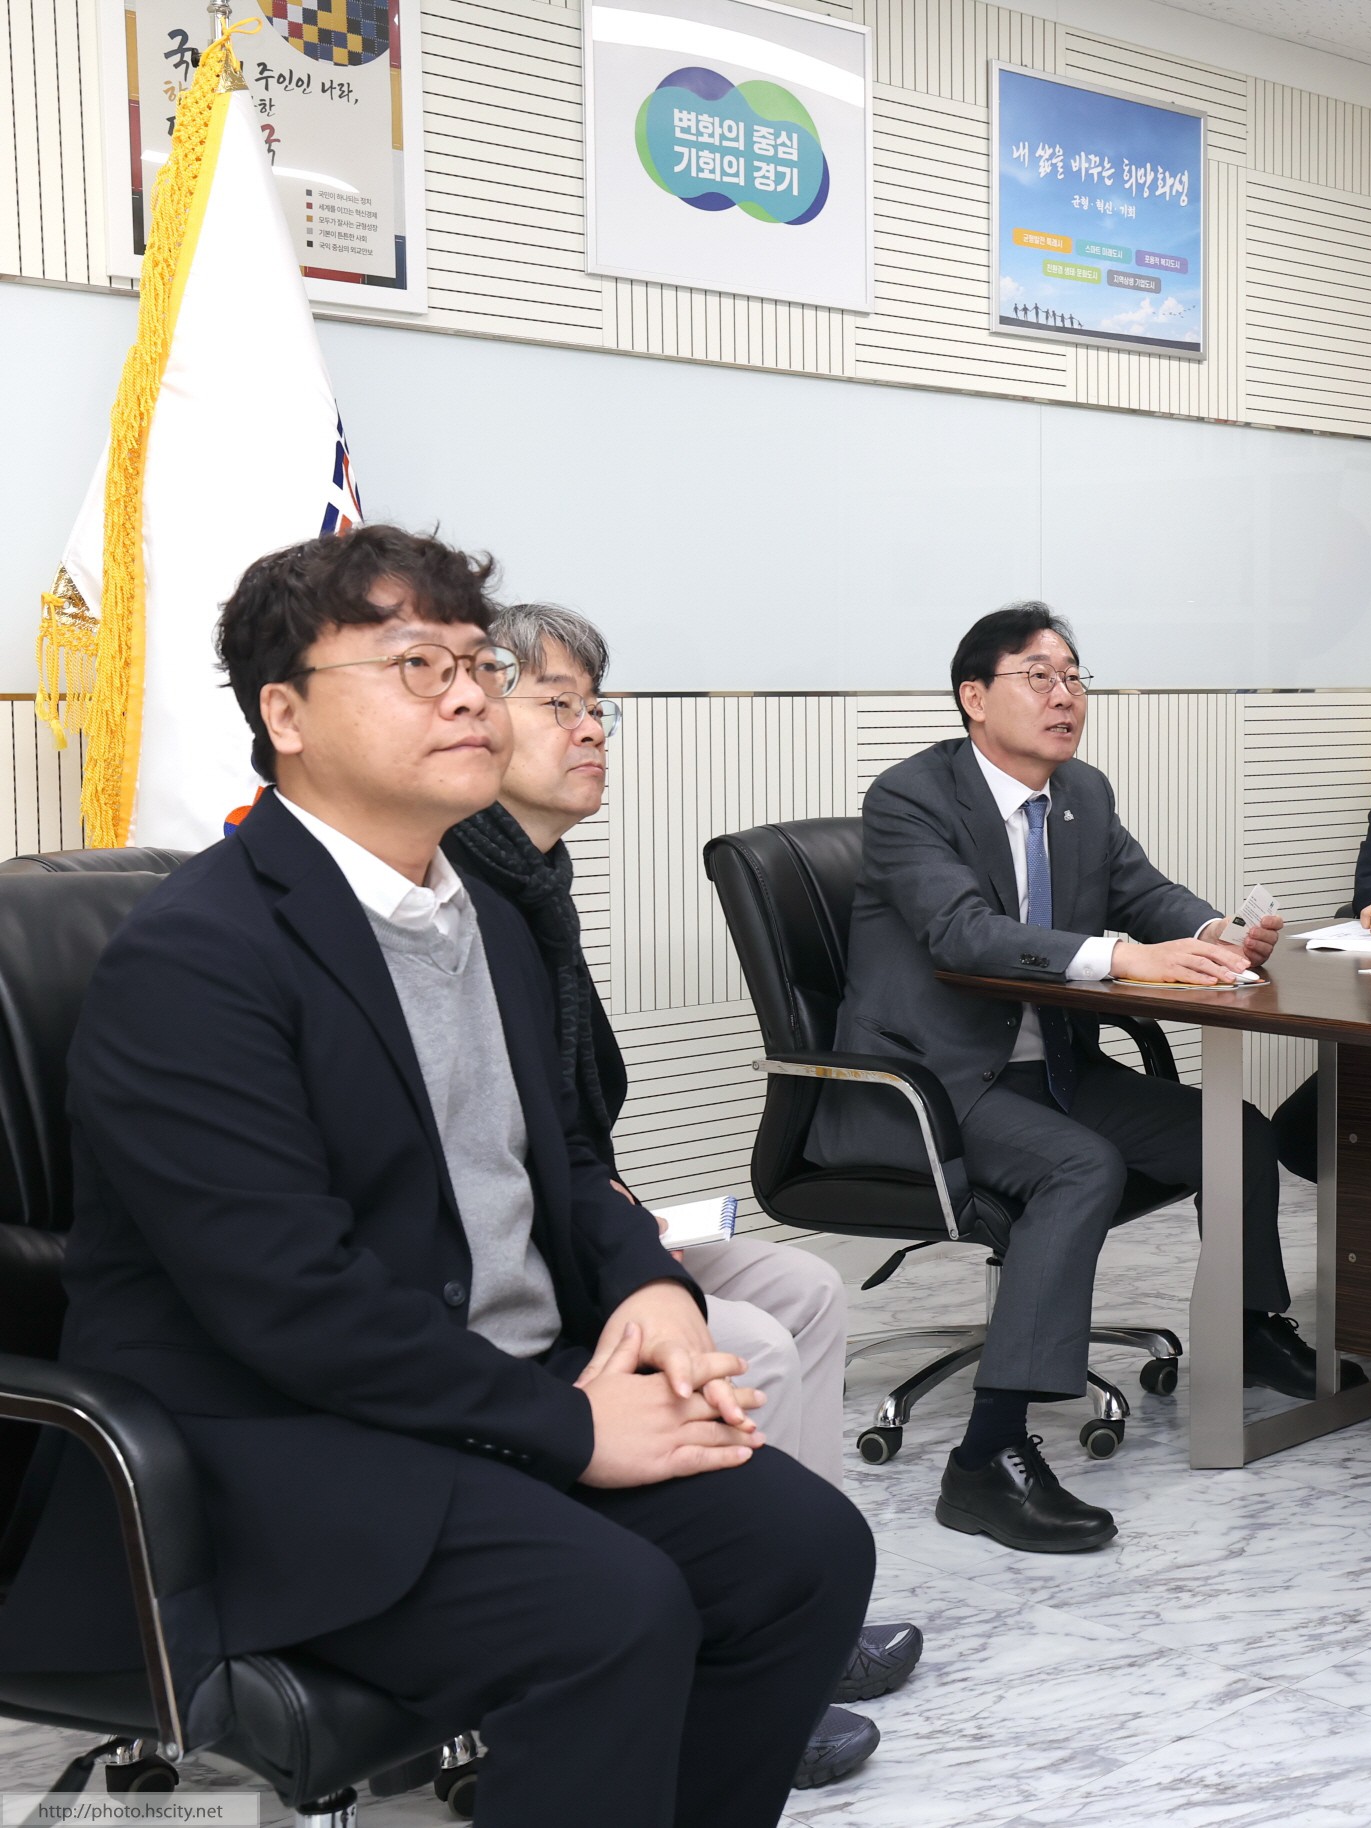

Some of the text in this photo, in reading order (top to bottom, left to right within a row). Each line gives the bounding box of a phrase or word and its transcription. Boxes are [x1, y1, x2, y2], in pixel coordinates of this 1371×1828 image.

[254, 62, 312, 94] 주인인
[673, 108, 798, 162] 변화의 중심
[673, 146, 798, 196] 기회의 경기
[1012, 141, 1028, 168] 내
[1035, 142, 1064, 180] 삶을
[1070, 151, 1116, 186] 바꾸는
[318, 216, 336, 226] 모두가
